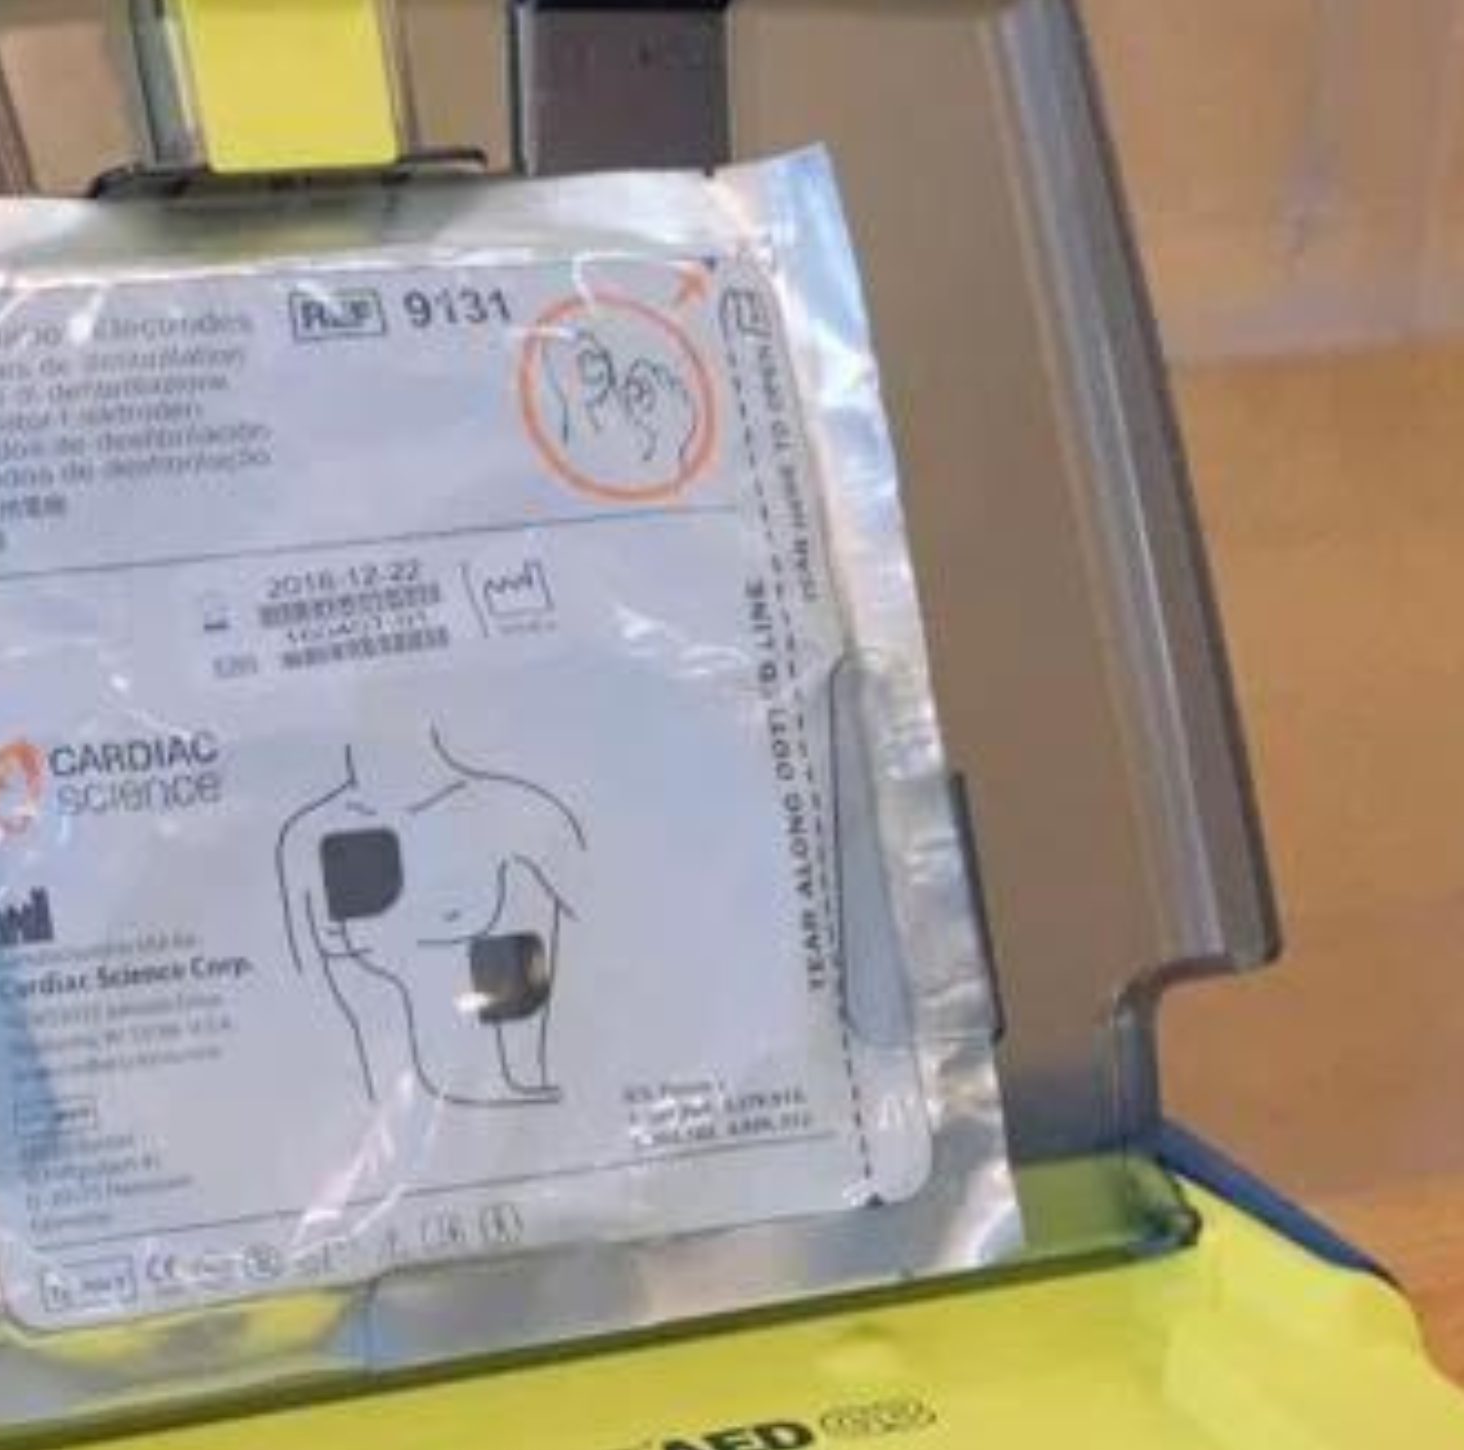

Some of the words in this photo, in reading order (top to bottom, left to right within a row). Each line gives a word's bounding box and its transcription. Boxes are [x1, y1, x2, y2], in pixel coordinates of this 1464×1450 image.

[402, 284, 512, 329] 9131
[49, 728, 220, 778] CARDIAC
[758, 661, 796, 782] DOTTD
[782, 792, 815, 899] ALONG
